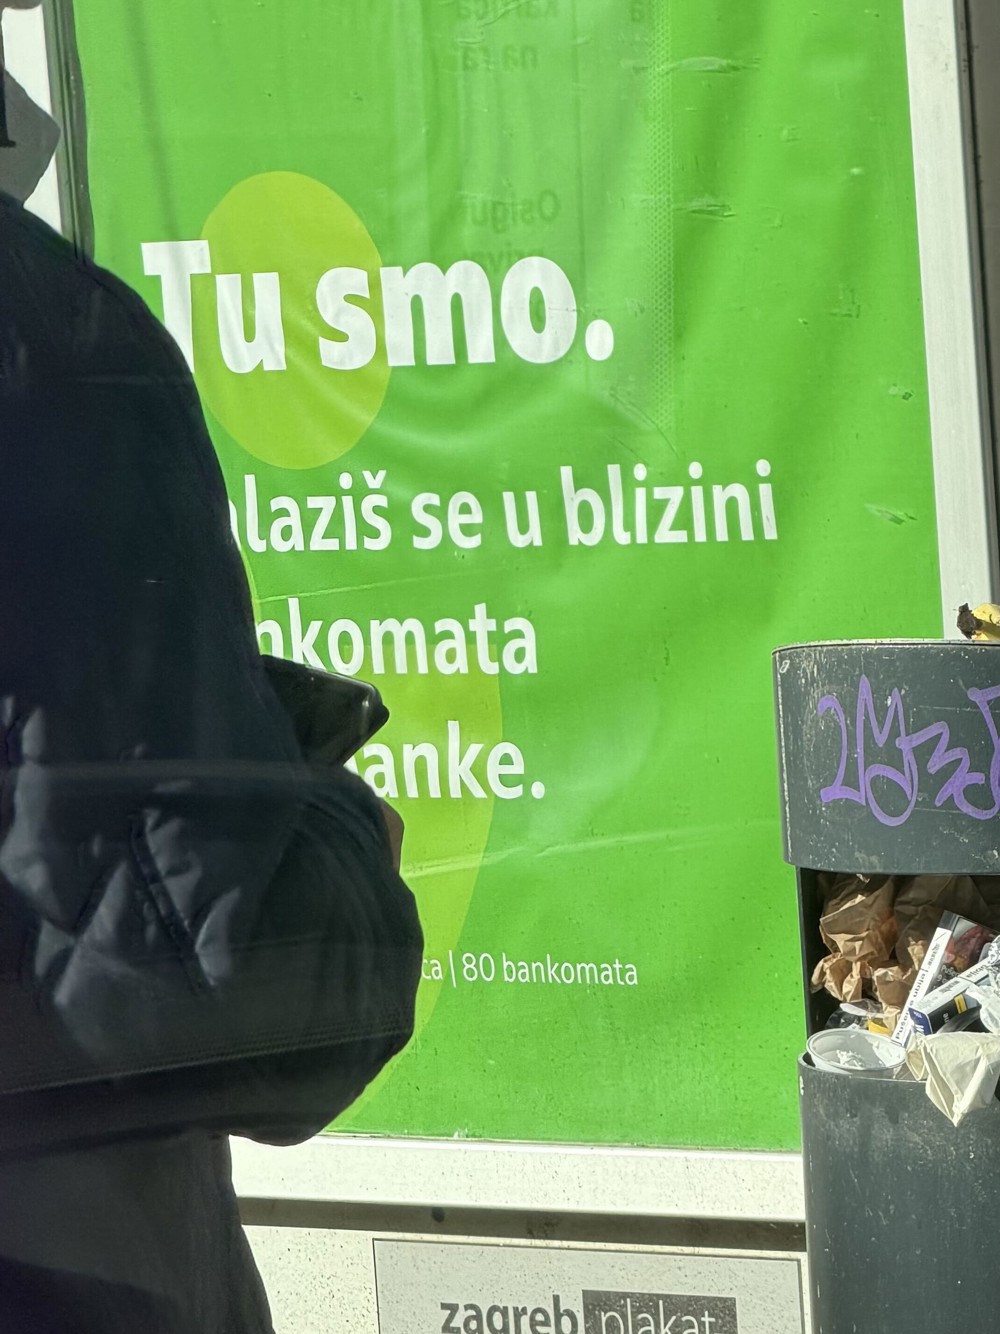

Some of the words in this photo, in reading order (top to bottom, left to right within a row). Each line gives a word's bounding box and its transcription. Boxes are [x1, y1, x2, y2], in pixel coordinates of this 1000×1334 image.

[141, 239, 287, 374] Tu
[315, 255, 615, 370] smo.
[229, 469, 392, 553] laziš
[411, 488, 484, 549] se
[503, 490, 543, 547] u
[559, 458, 778, 547] blizini
[256, 597, 538, 676] nkomata
[343, 720, 546, 800] anke.
[421, 958, 444, 981] ca
[462, 952, 496, 982] 80
[502, 952, 639, 986] bankomata
